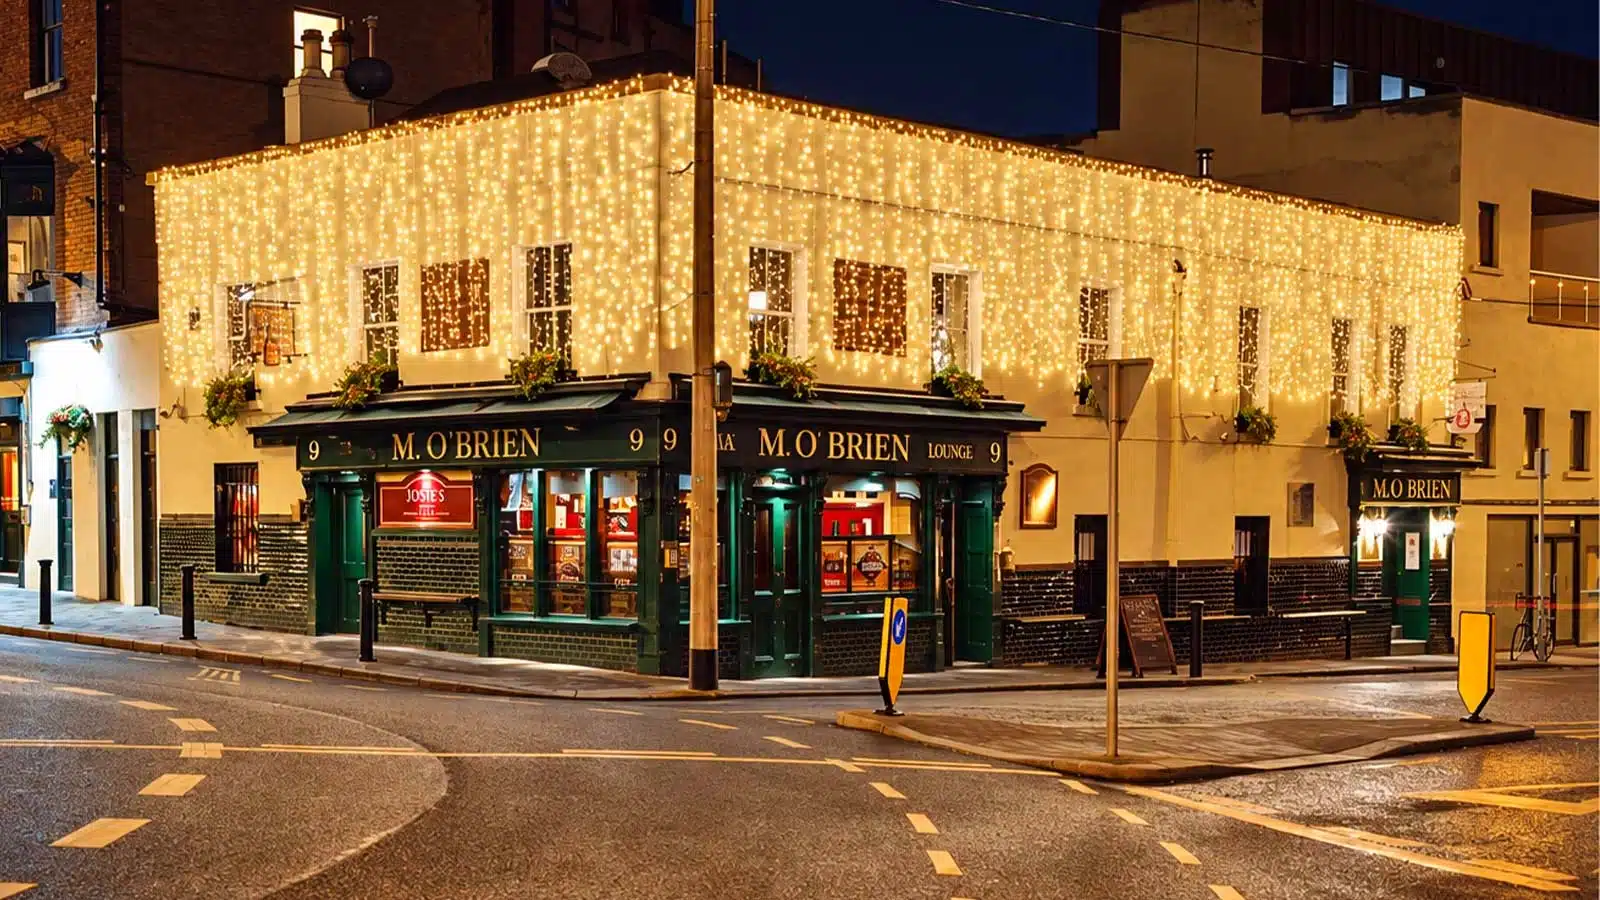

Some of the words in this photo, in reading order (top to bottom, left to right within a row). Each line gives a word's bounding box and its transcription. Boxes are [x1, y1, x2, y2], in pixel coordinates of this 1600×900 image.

[309, 440, 320, 461] 9
[426, 428, 541, 459] O'BRIEN
[629, 428, 643, 451] 9
[663, 428, 677, 451] 9
[928, 442, 974, 460] LOUNGE
[990, 442, 1002, 463] 9
